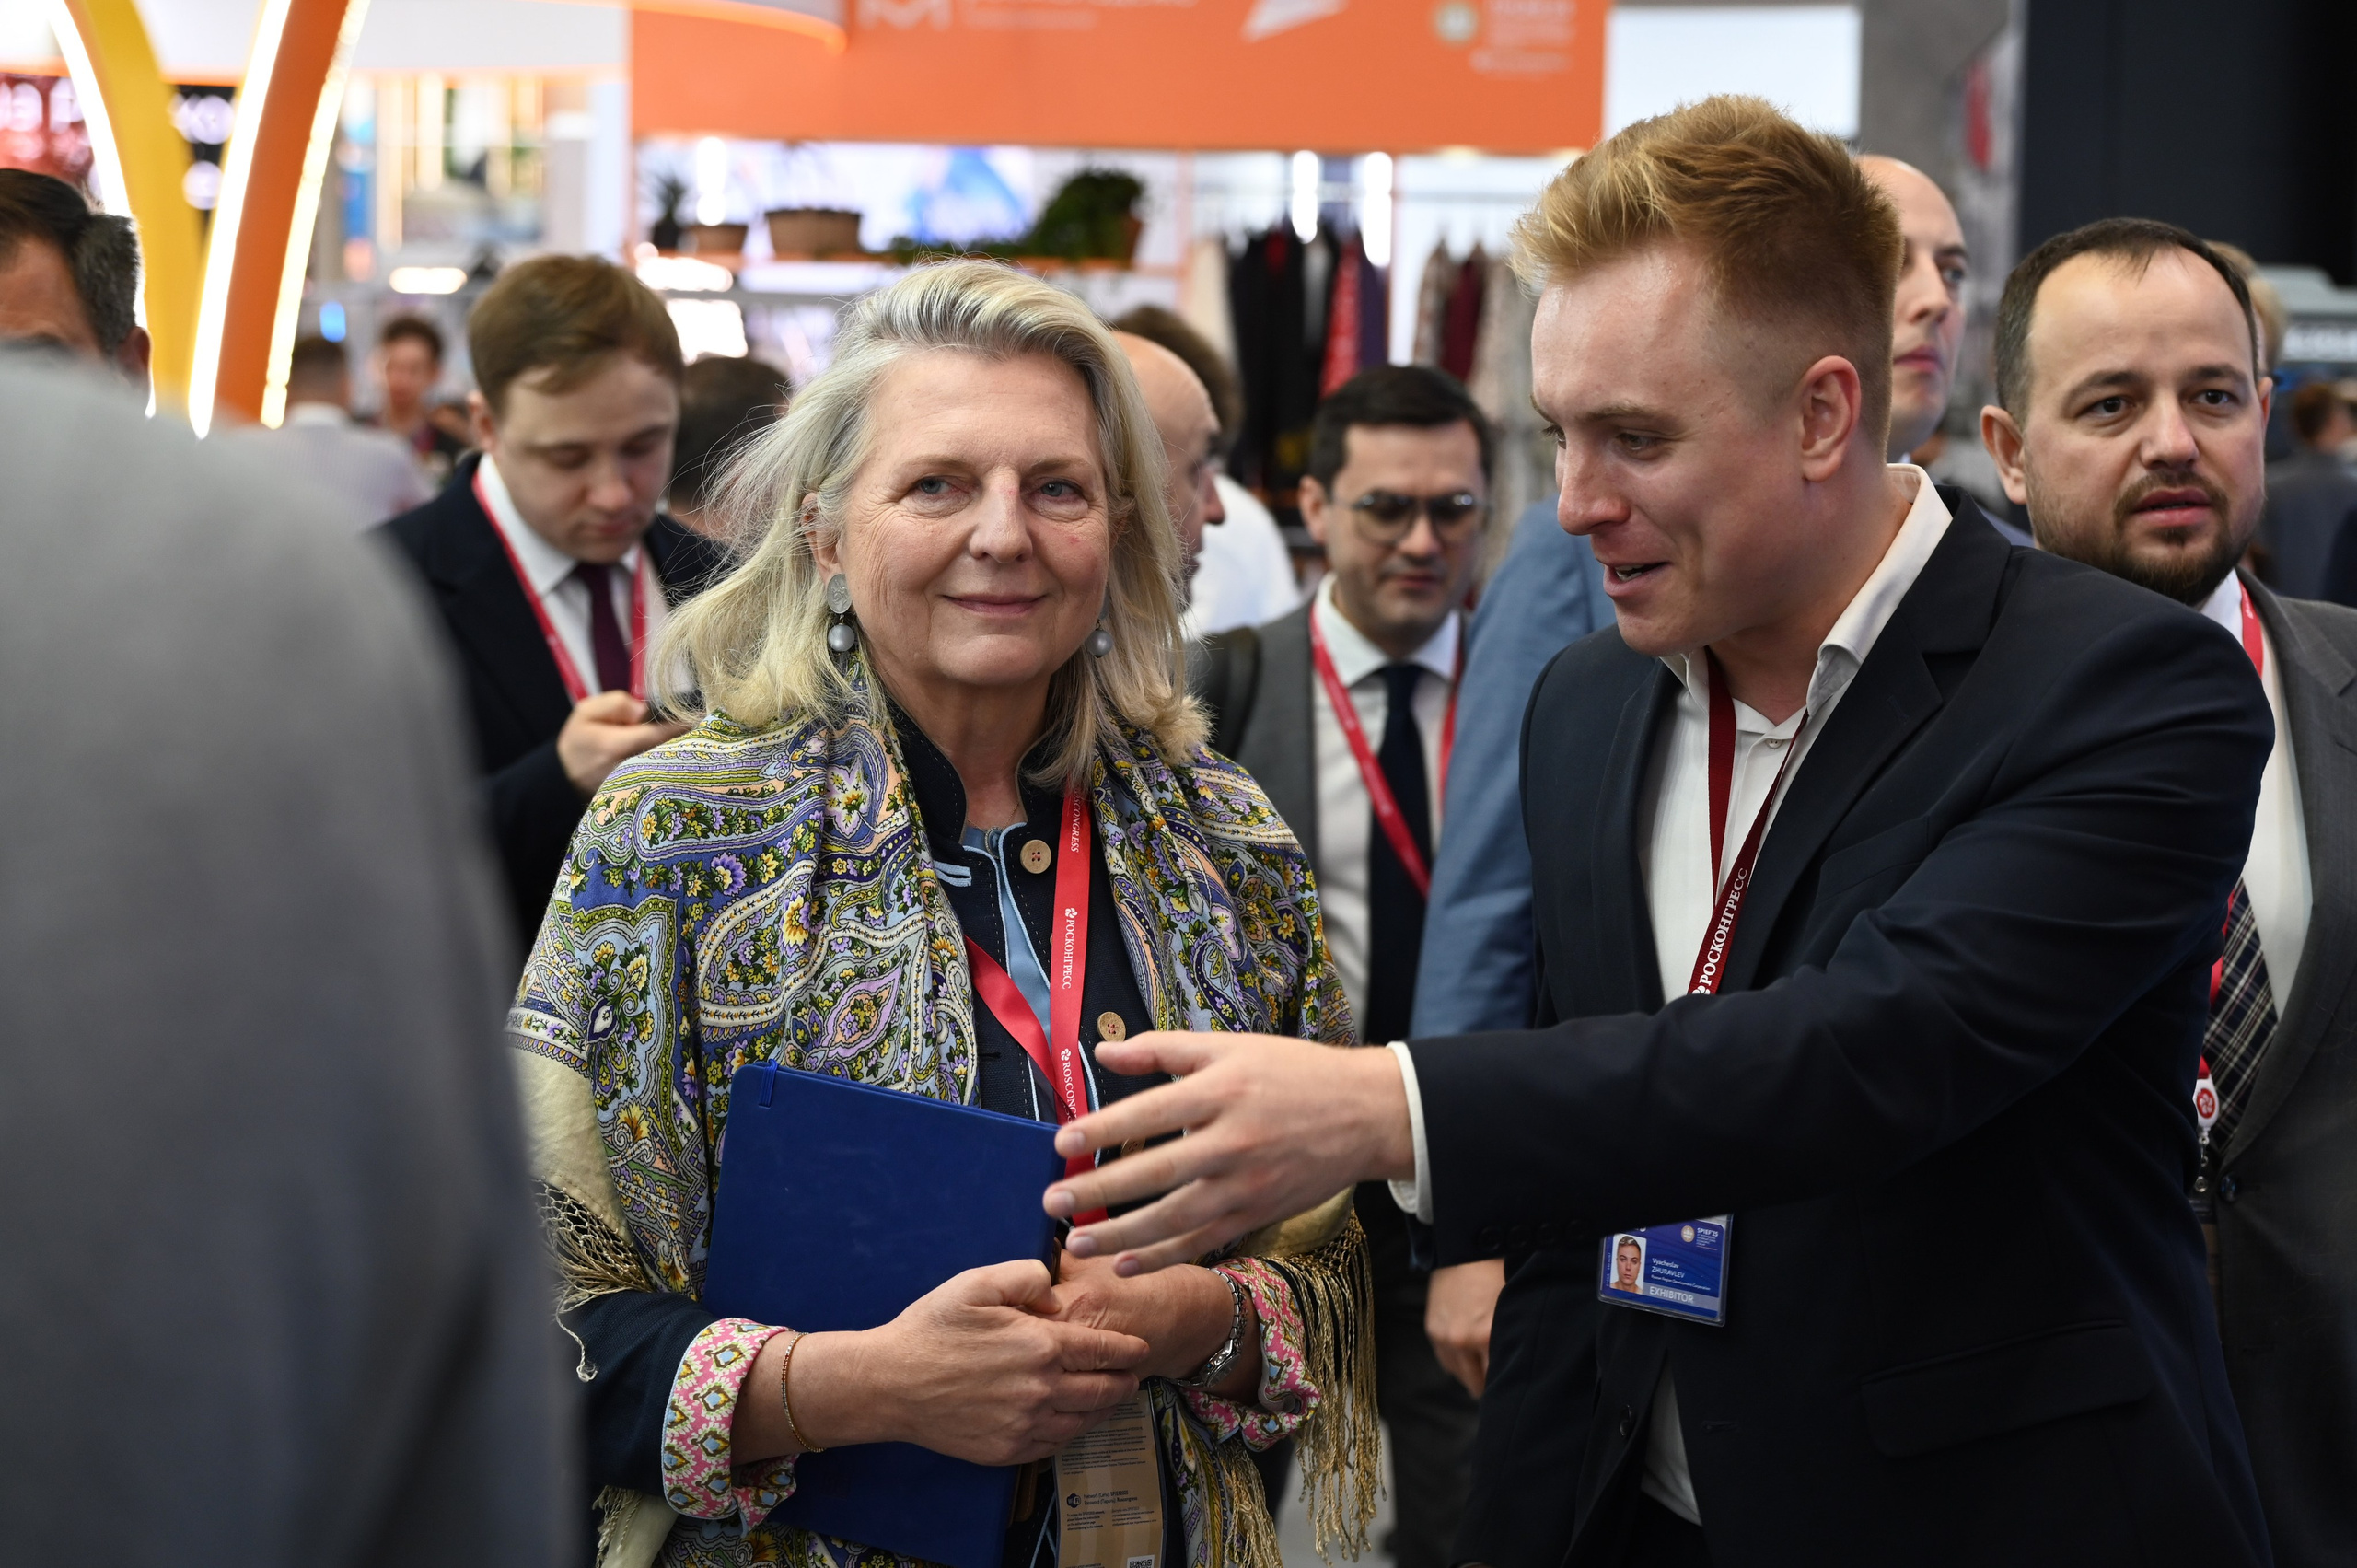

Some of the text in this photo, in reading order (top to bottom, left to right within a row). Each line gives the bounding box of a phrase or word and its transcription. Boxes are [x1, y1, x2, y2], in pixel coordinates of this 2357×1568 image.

[1699, 867, 1747, 986] РОСКОНГРЕСС
[1062, 919, 1075, 990] РОСКОНГРЕСС
[1651, 1266, 1685, 1279] ZHURAVLEV
[1649, 1286, 1694, 1304] EXHIBITOR
